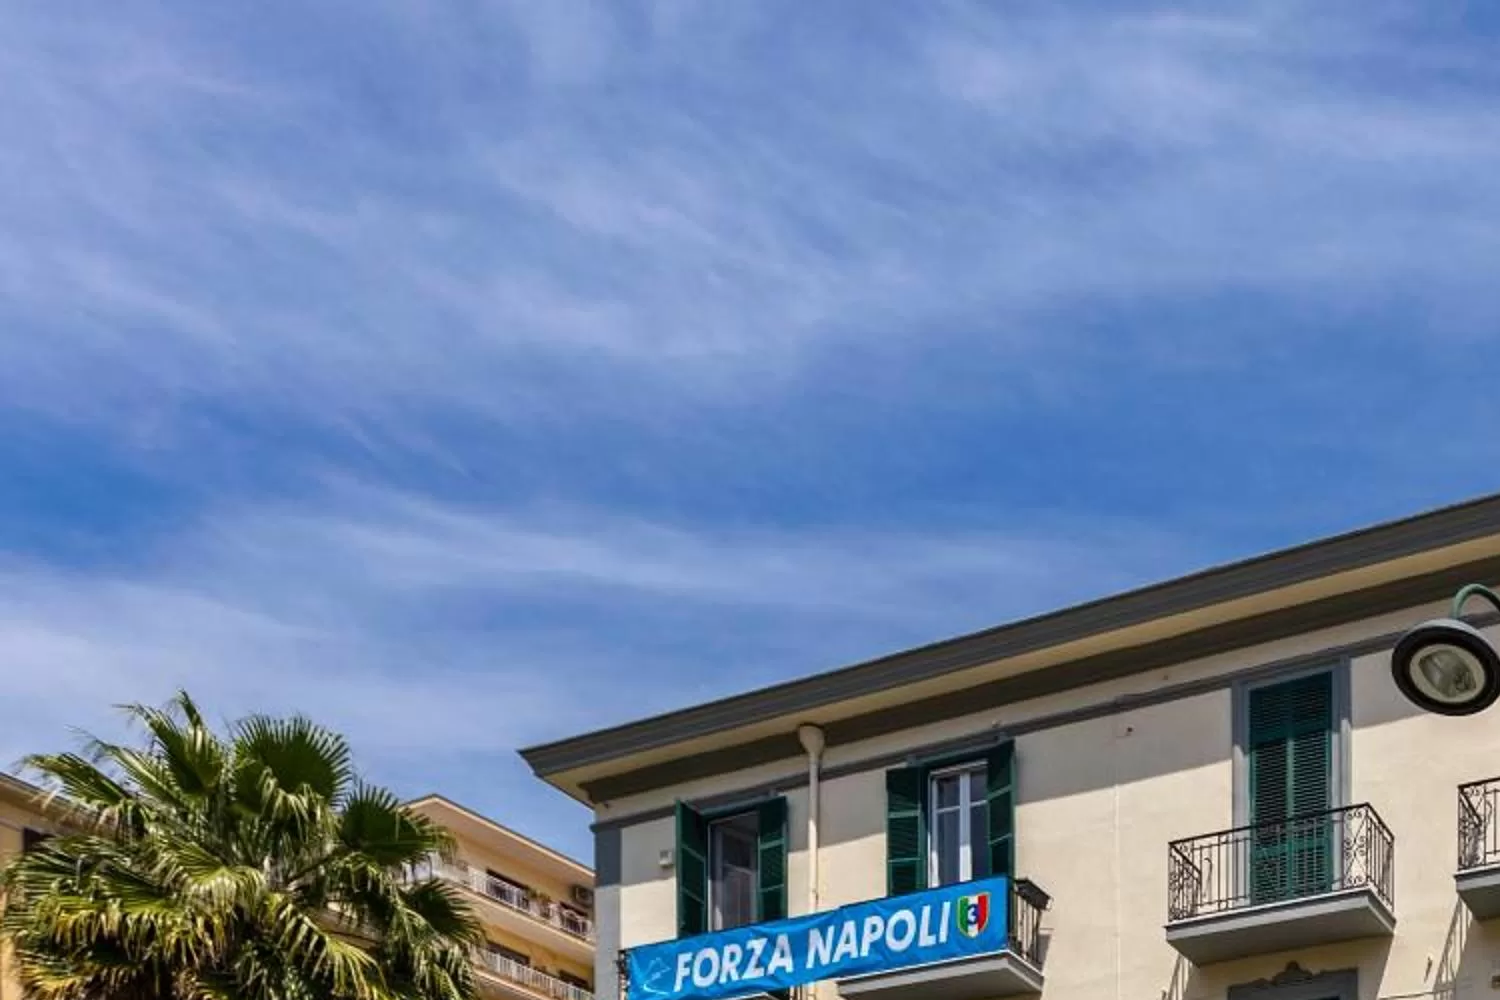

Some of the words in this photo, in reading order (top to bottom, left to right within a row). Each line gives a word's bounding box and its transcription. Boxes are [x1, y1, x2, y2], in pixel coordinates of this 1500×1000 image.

[967, 904, 979, 924] 3
[673, 936, 793, 992] FORZA
[806, 901, 950, 969] NAPOLI
